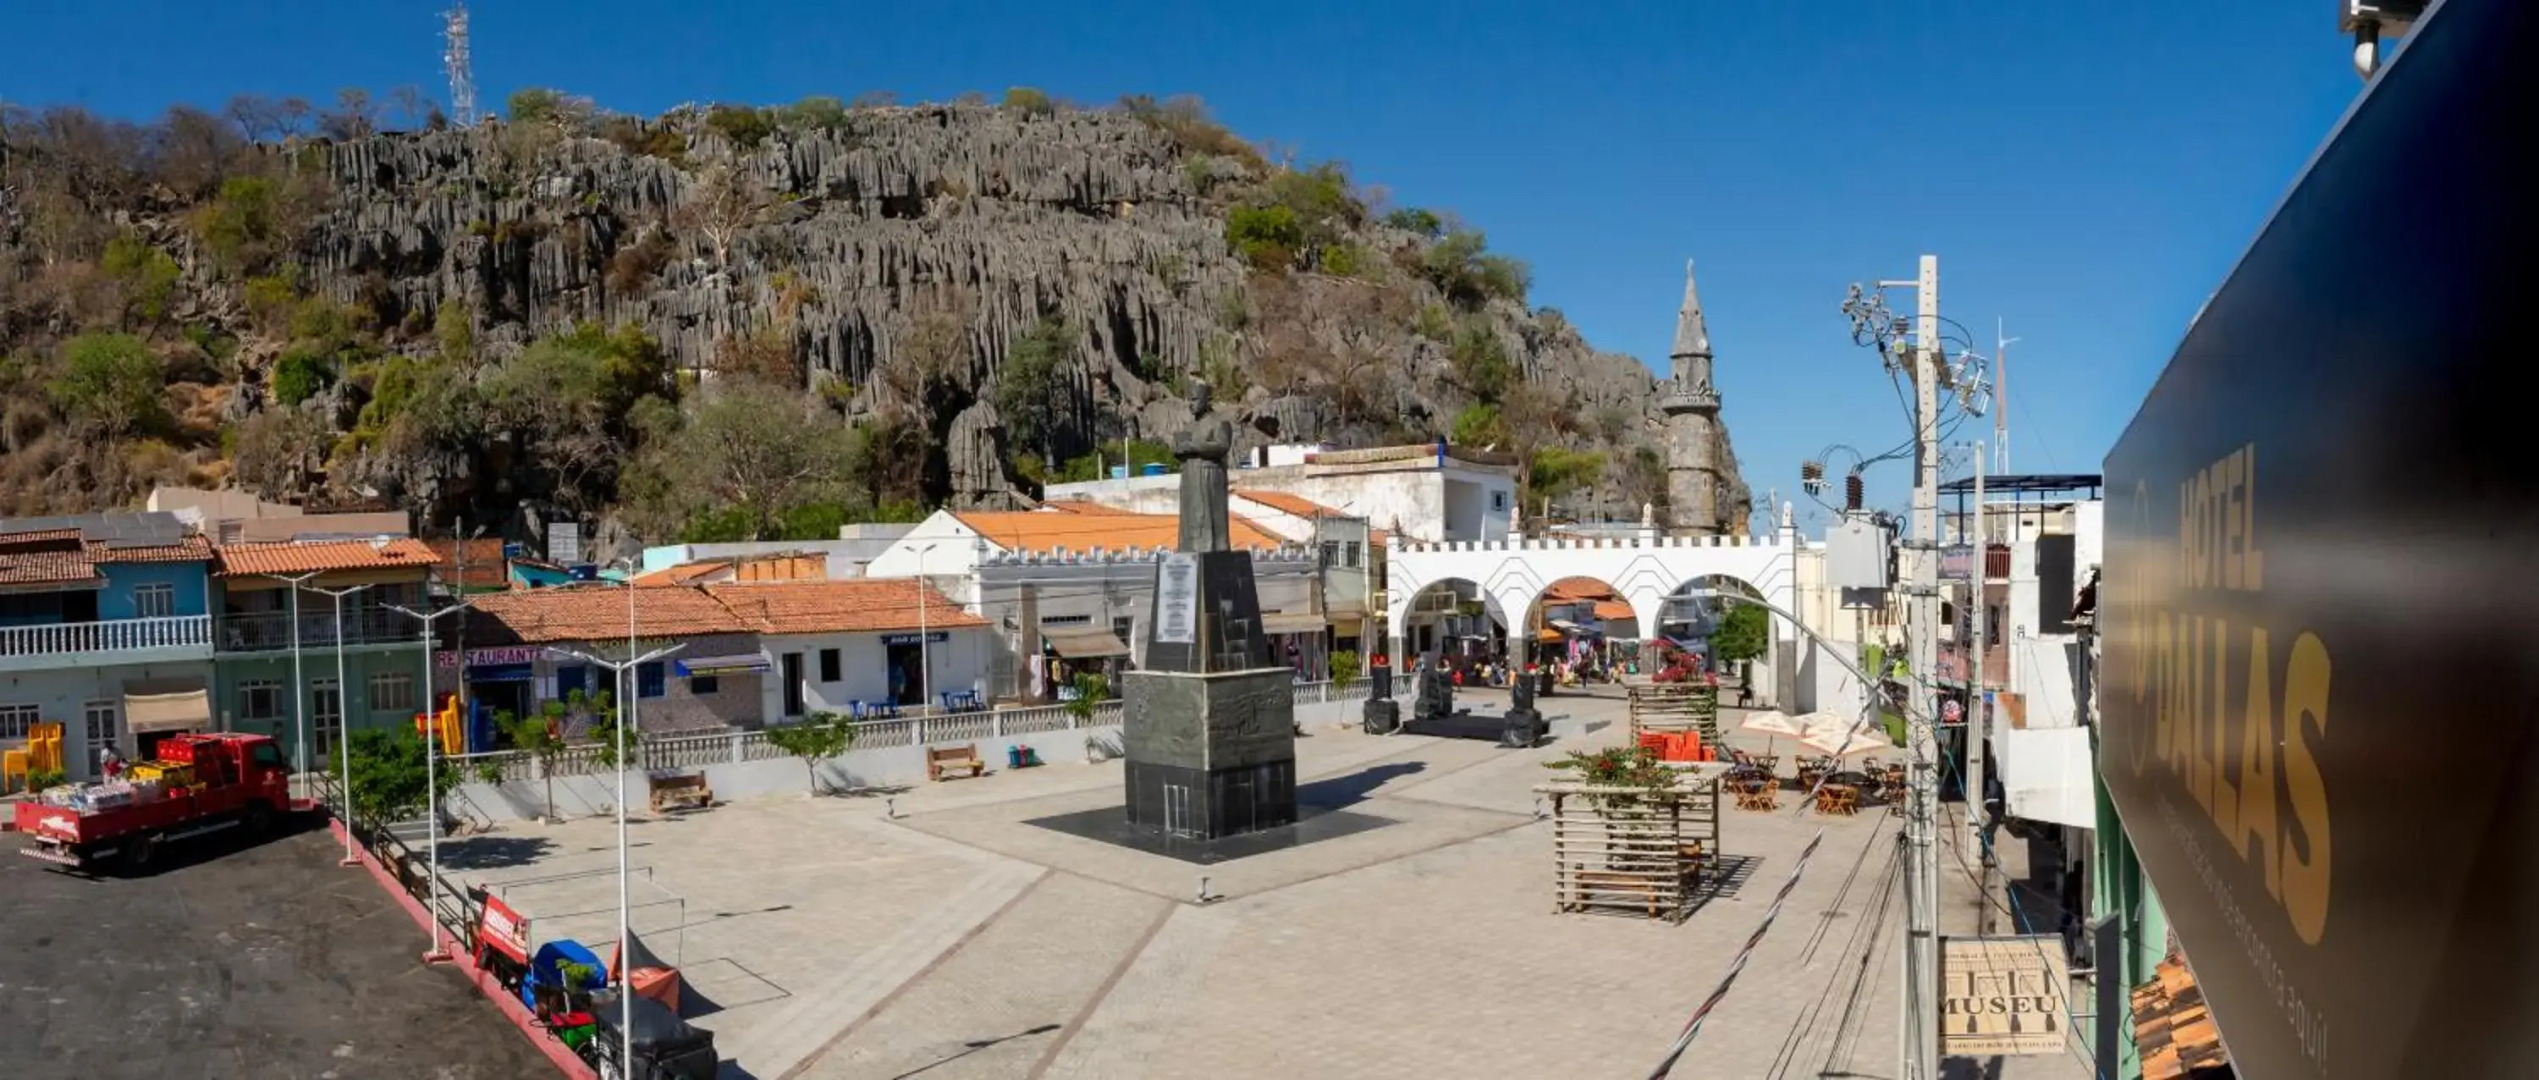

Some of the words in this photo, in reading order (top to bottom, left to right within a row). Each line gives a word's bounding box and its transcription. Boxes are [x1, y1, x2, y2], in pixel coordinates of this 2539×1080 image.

[2180, 442, 2264, 592] HOTEL
[439, 648, 542, 666] RESTAURANTE
[599, 638, 675, 649] POUADA
[2156, 611, 2332, 945] DALLAS
[1939, 996, 2057, 1015] MUSEU
[2287, 985, 2328, 1077] aqui!
